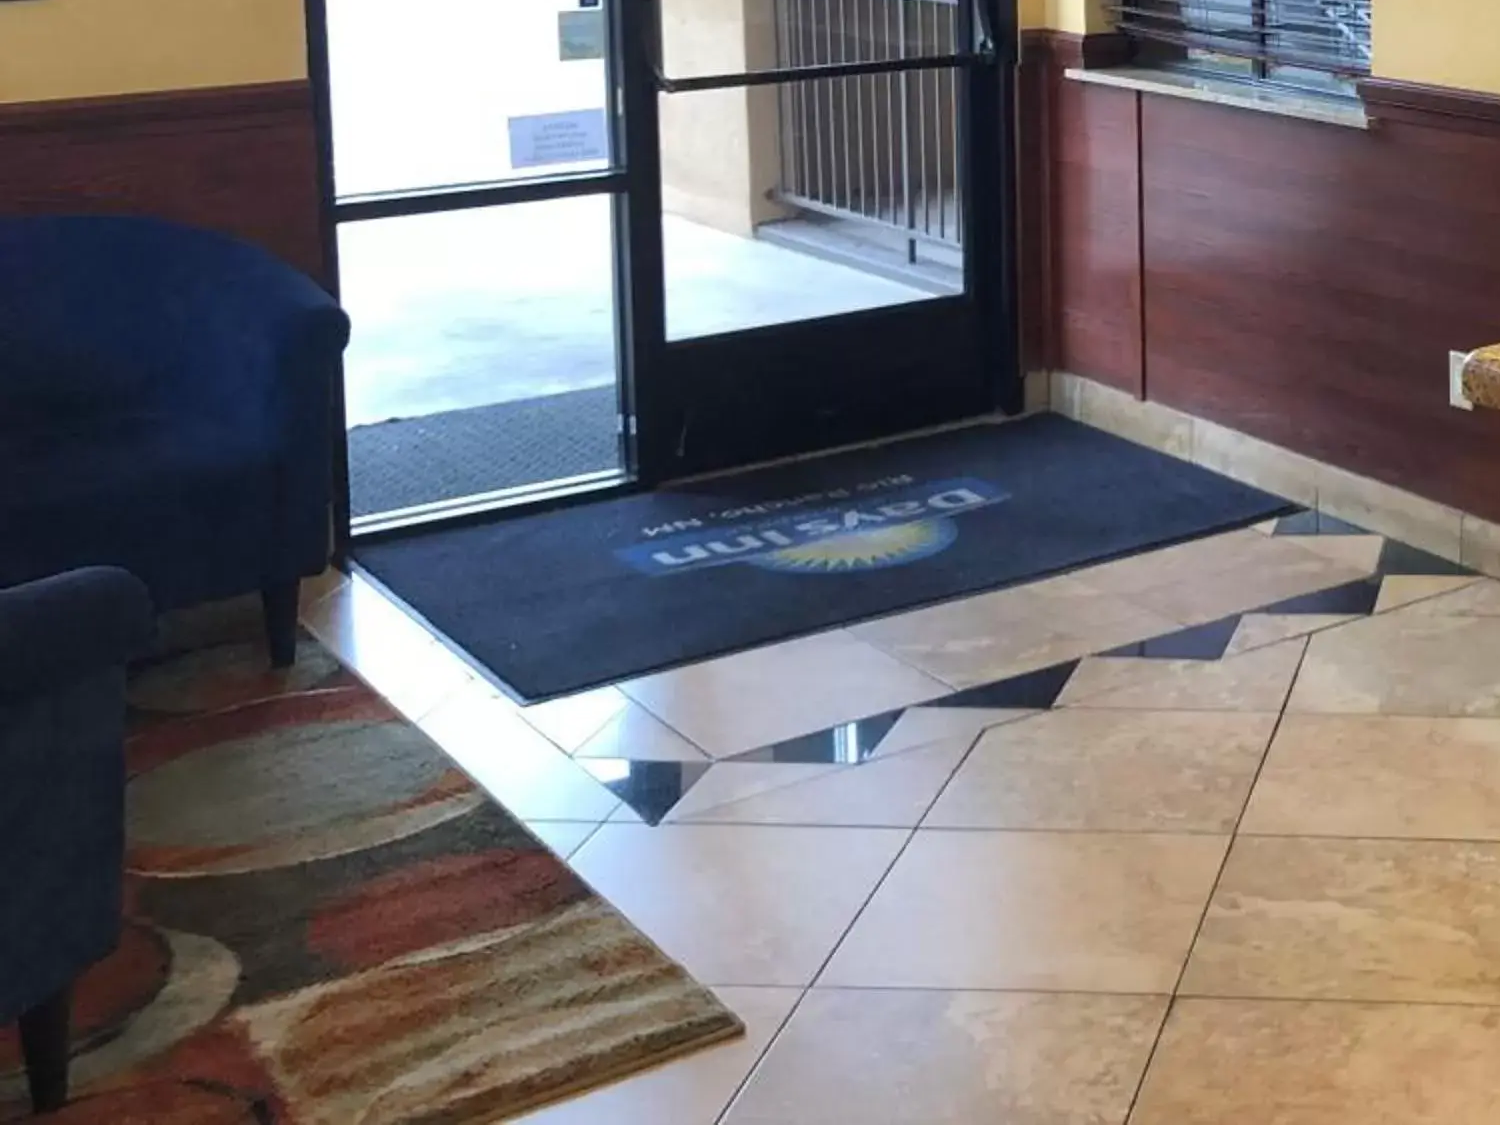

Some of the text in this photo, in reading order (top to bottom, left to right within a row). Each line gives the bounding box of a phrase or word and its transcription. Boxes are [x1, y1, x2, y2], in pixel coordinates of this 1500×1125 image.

[641, 517, 703, 537] NM
[795, 488, 987, 537] Days
[652, 529, 793, 565] Inn
